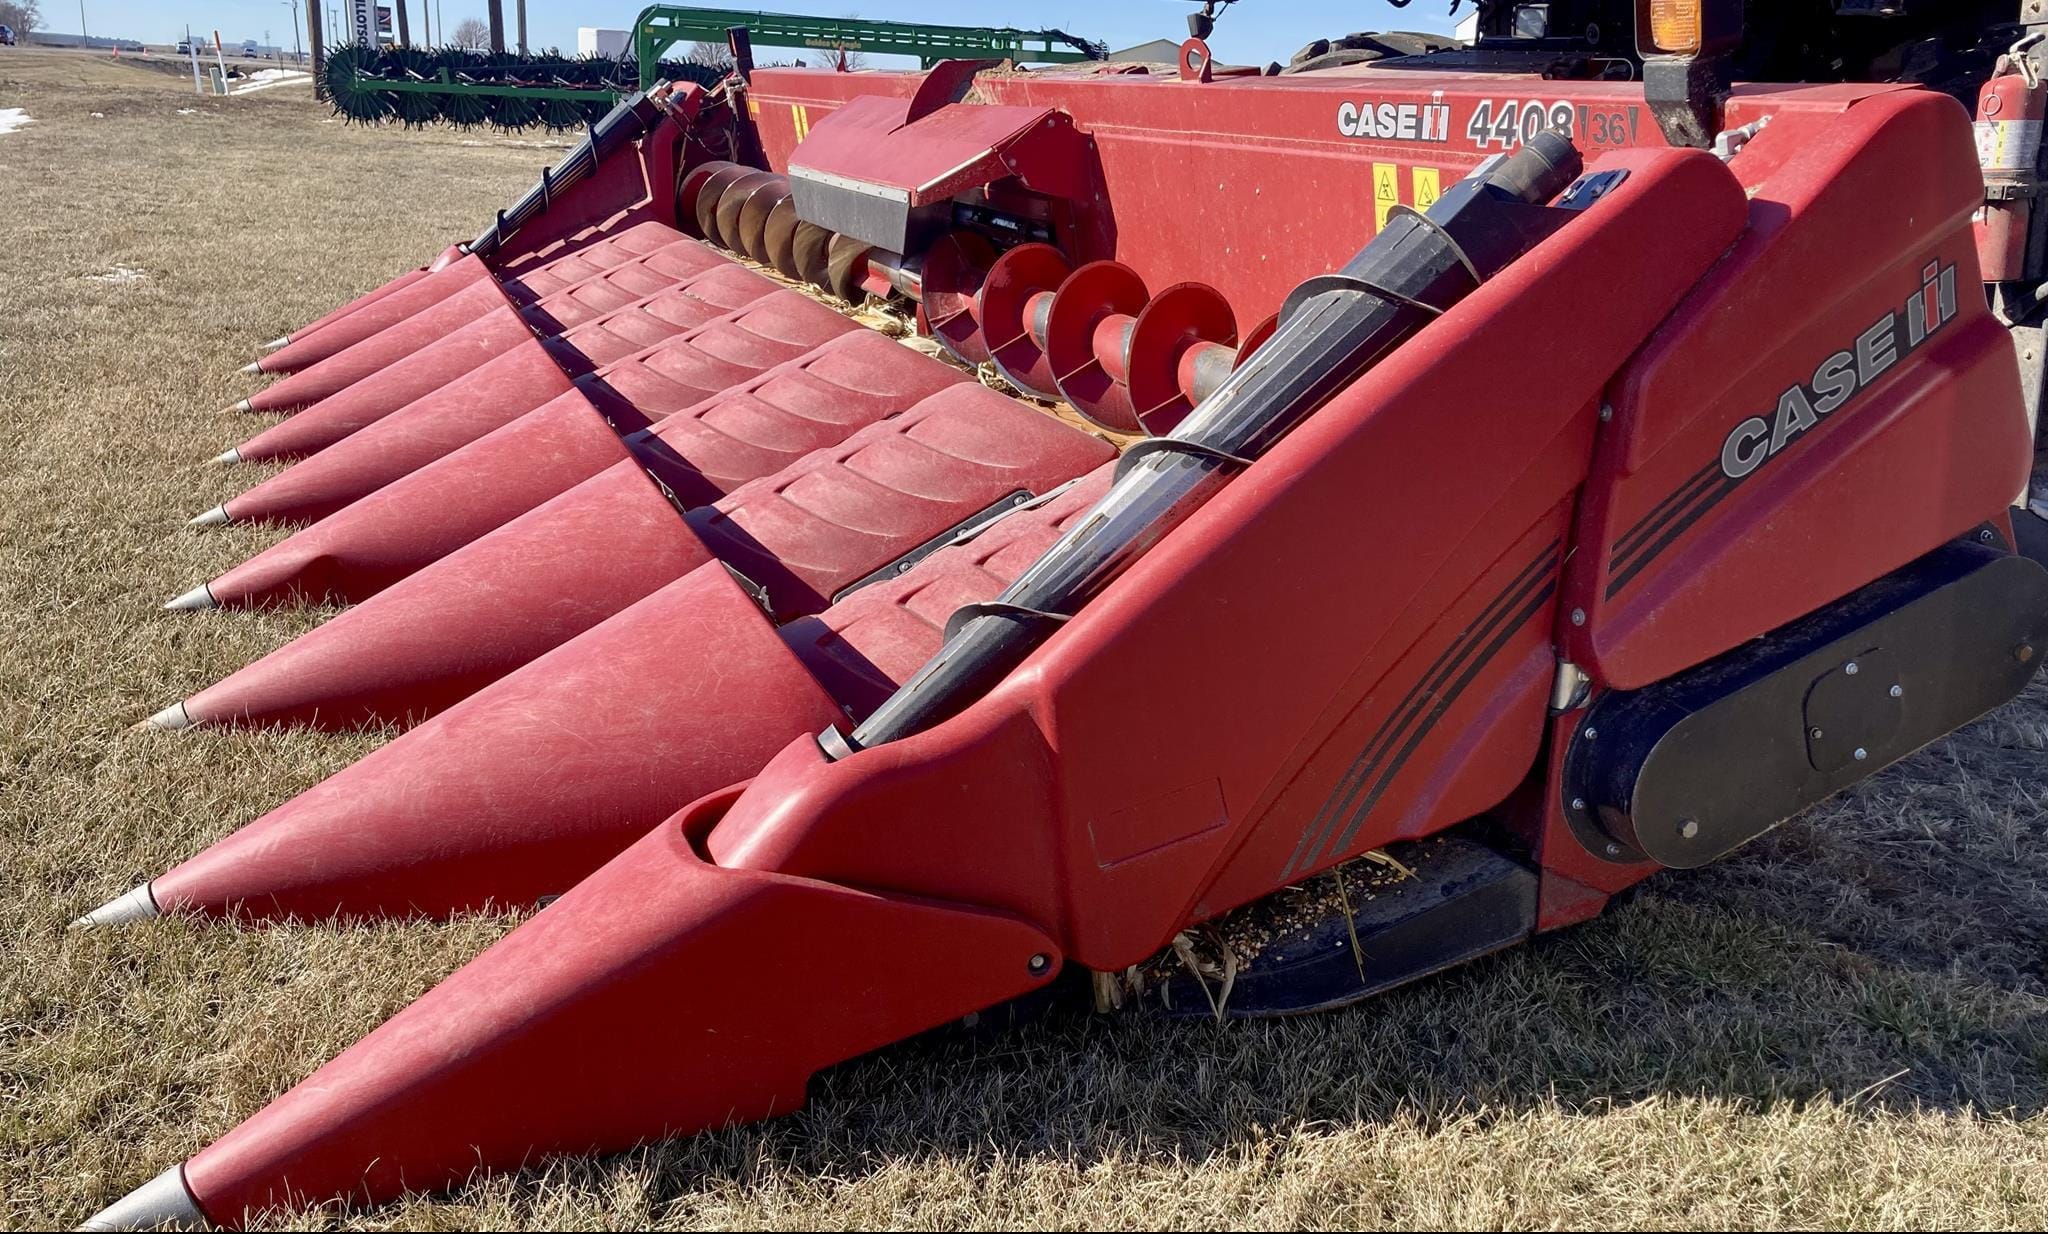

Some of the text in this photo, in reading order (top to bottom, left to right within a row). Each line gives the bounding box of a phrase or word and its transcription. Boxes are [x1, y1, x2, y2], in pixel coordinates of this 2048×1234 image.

[1337, 102, 1418, 139] CASE
[1467, 99, 1575, 149] 4408
[1592, 113, 1626, 144] 36
[1721, 312, 1898, 478] CASE
